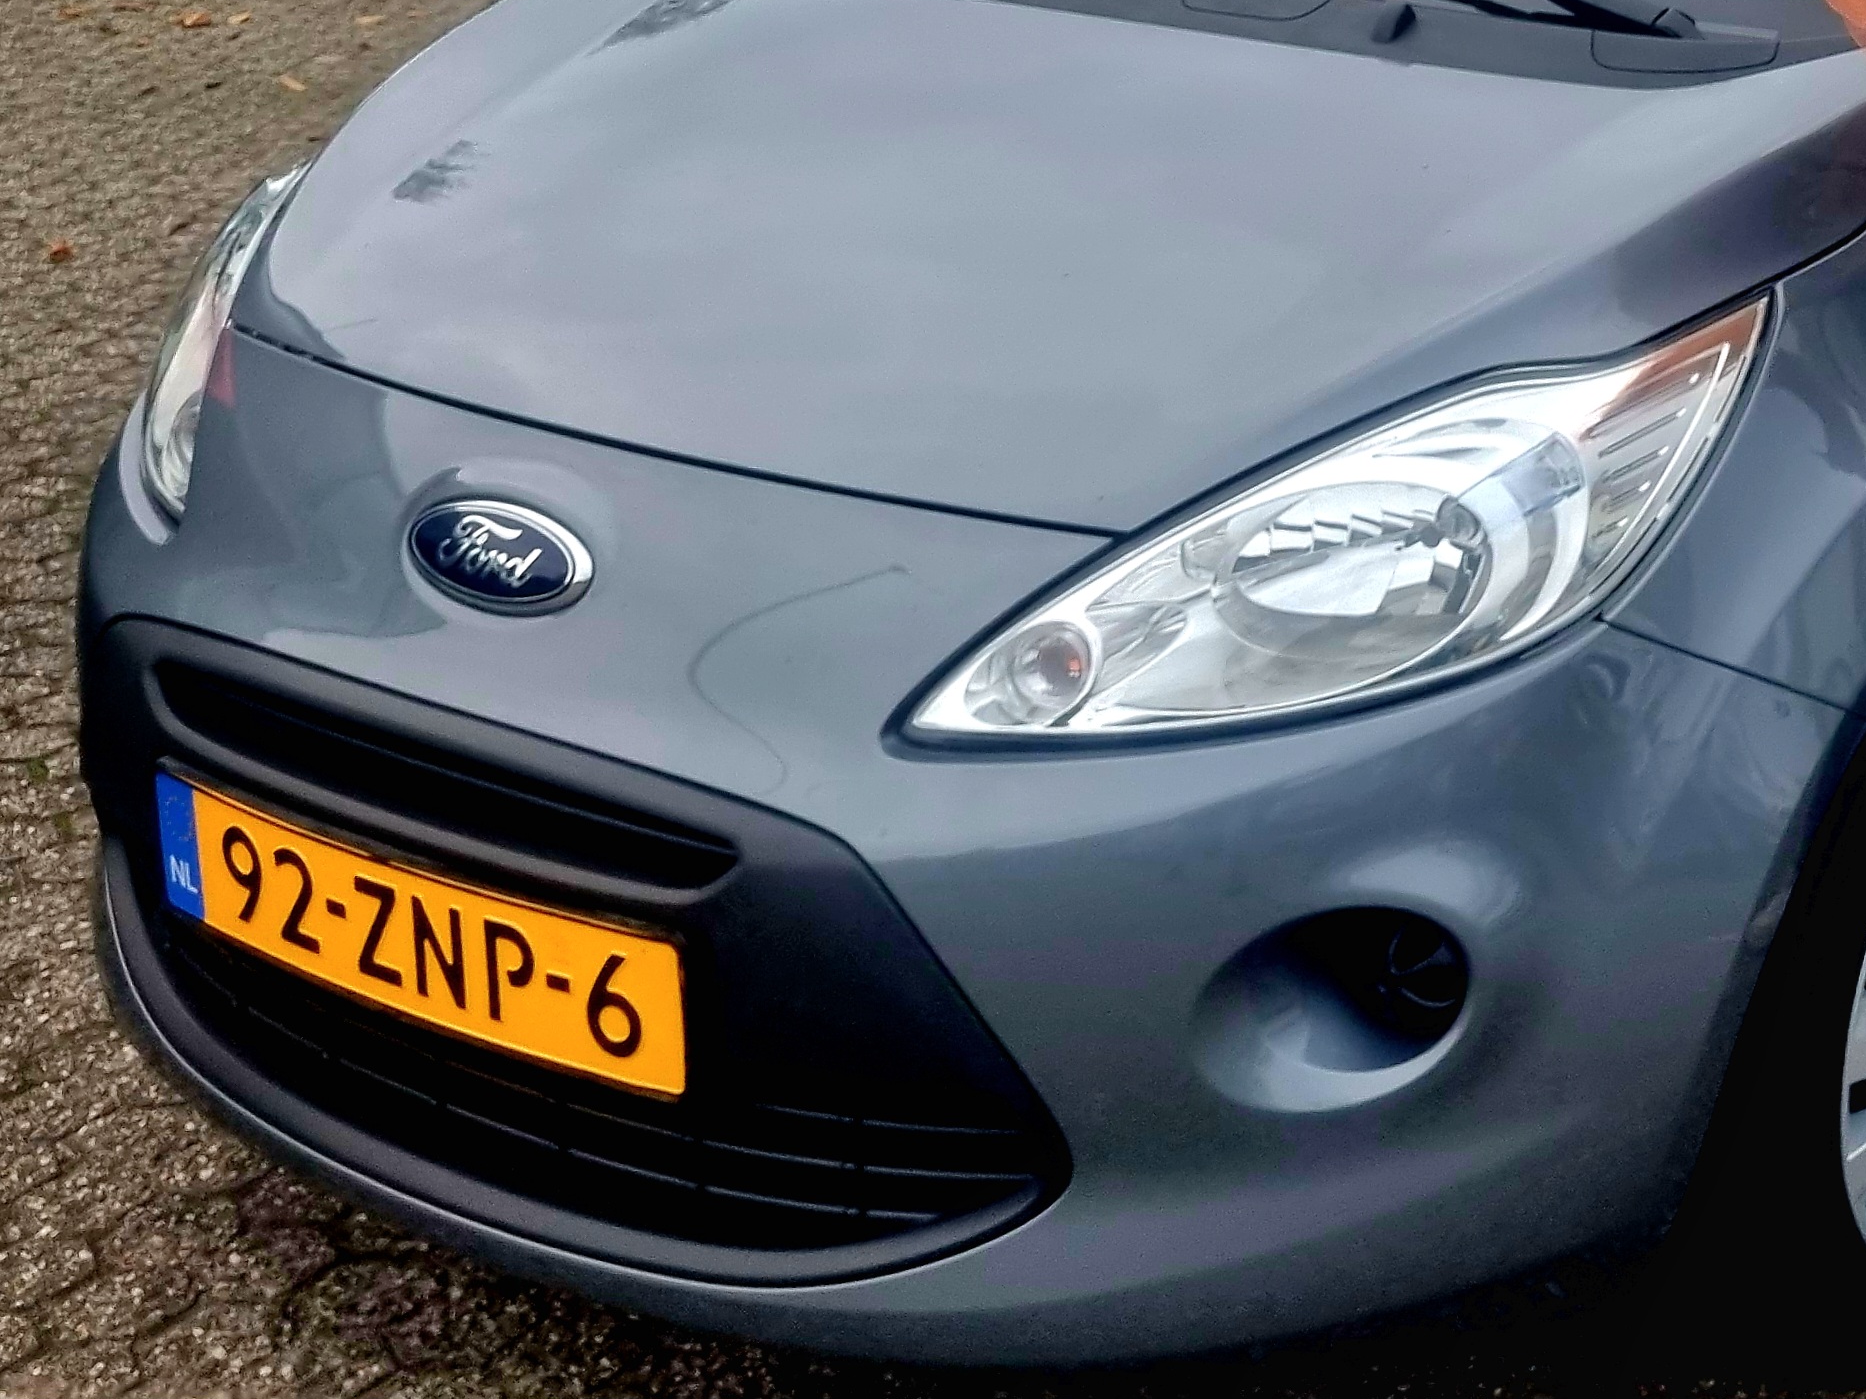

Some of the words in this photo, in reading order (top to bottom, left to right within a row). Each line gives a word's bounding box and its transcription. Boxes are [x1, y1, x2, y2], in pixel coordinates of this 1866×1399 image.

[438, 514, 543, 589] Ford
[169, 857, 199, 896] NL
[221, 824, 643, 1059] 92-ZNP-6
